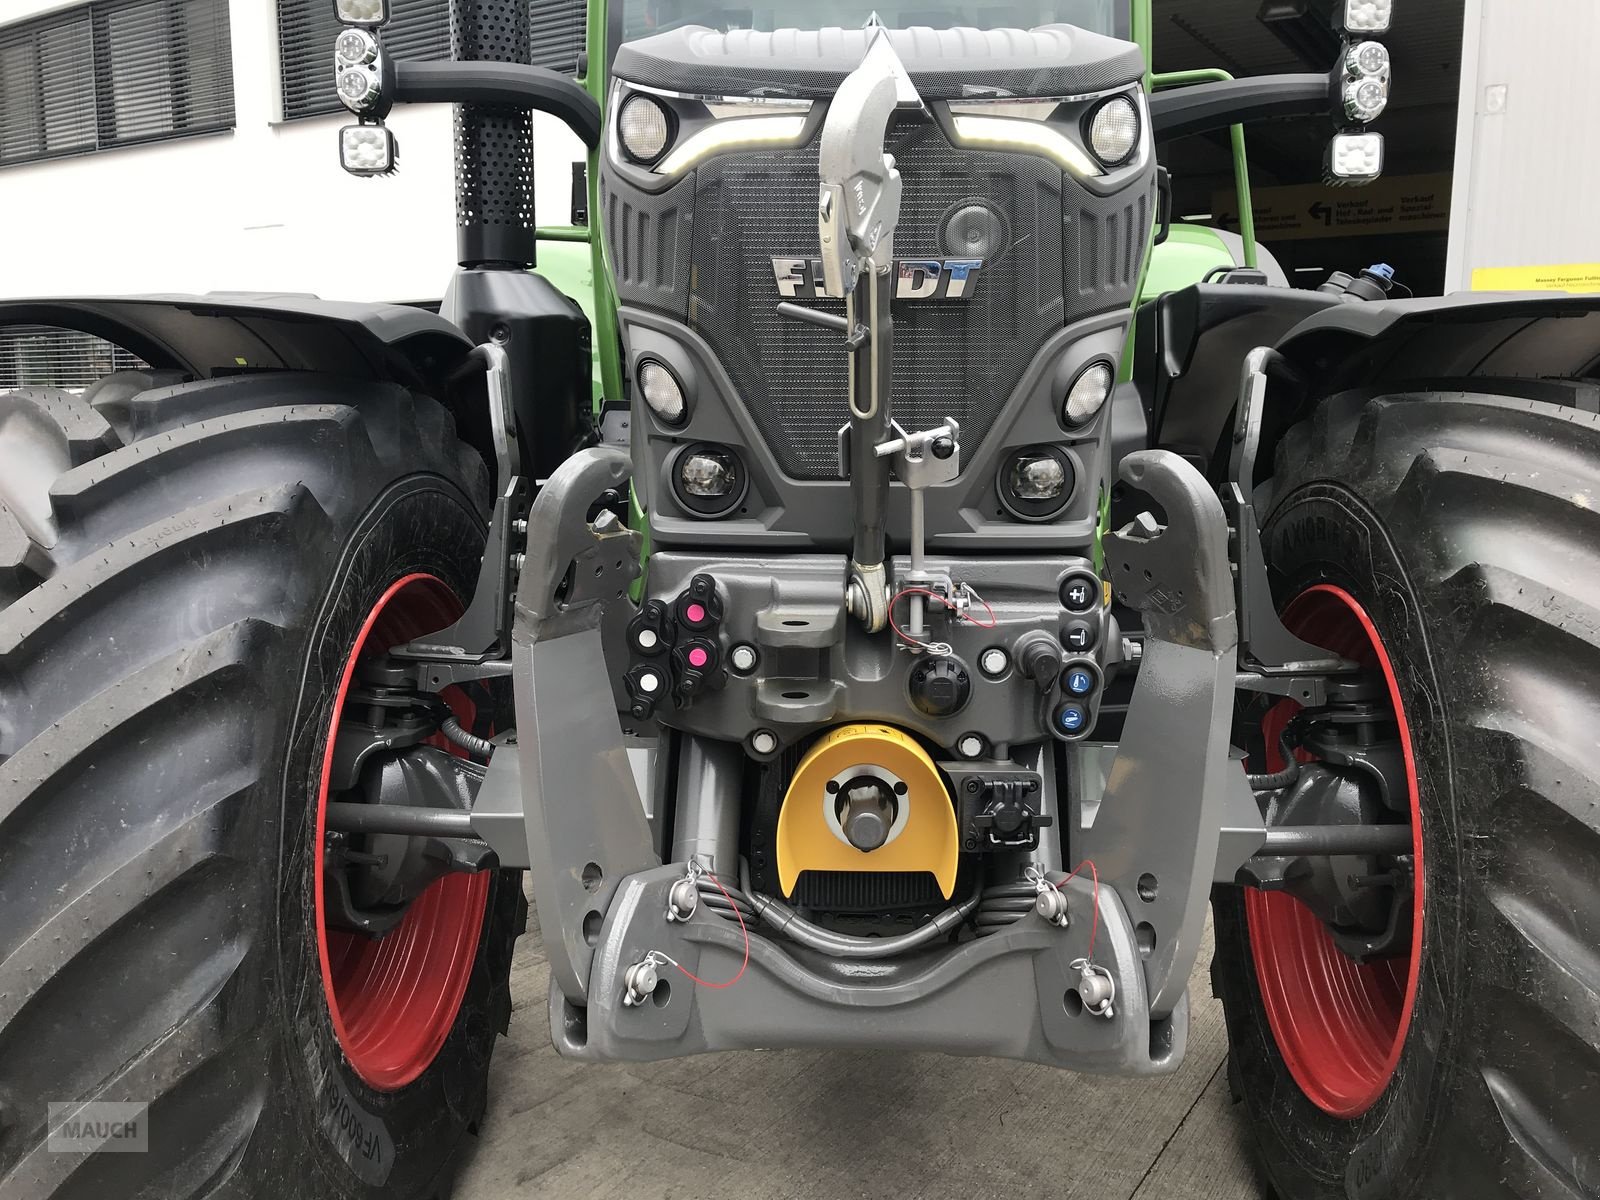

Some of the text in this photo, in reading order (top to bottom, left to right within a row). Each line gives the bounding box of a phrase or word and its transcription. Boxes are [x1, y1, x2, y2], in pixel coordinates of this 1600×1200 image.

[1400, 194, 1434, 204] Verkauf
[1336, 200, 1368, 209] Verkauf
[1377, 206, 1394, 214] und
[772, 258, 983, 298] FDT
